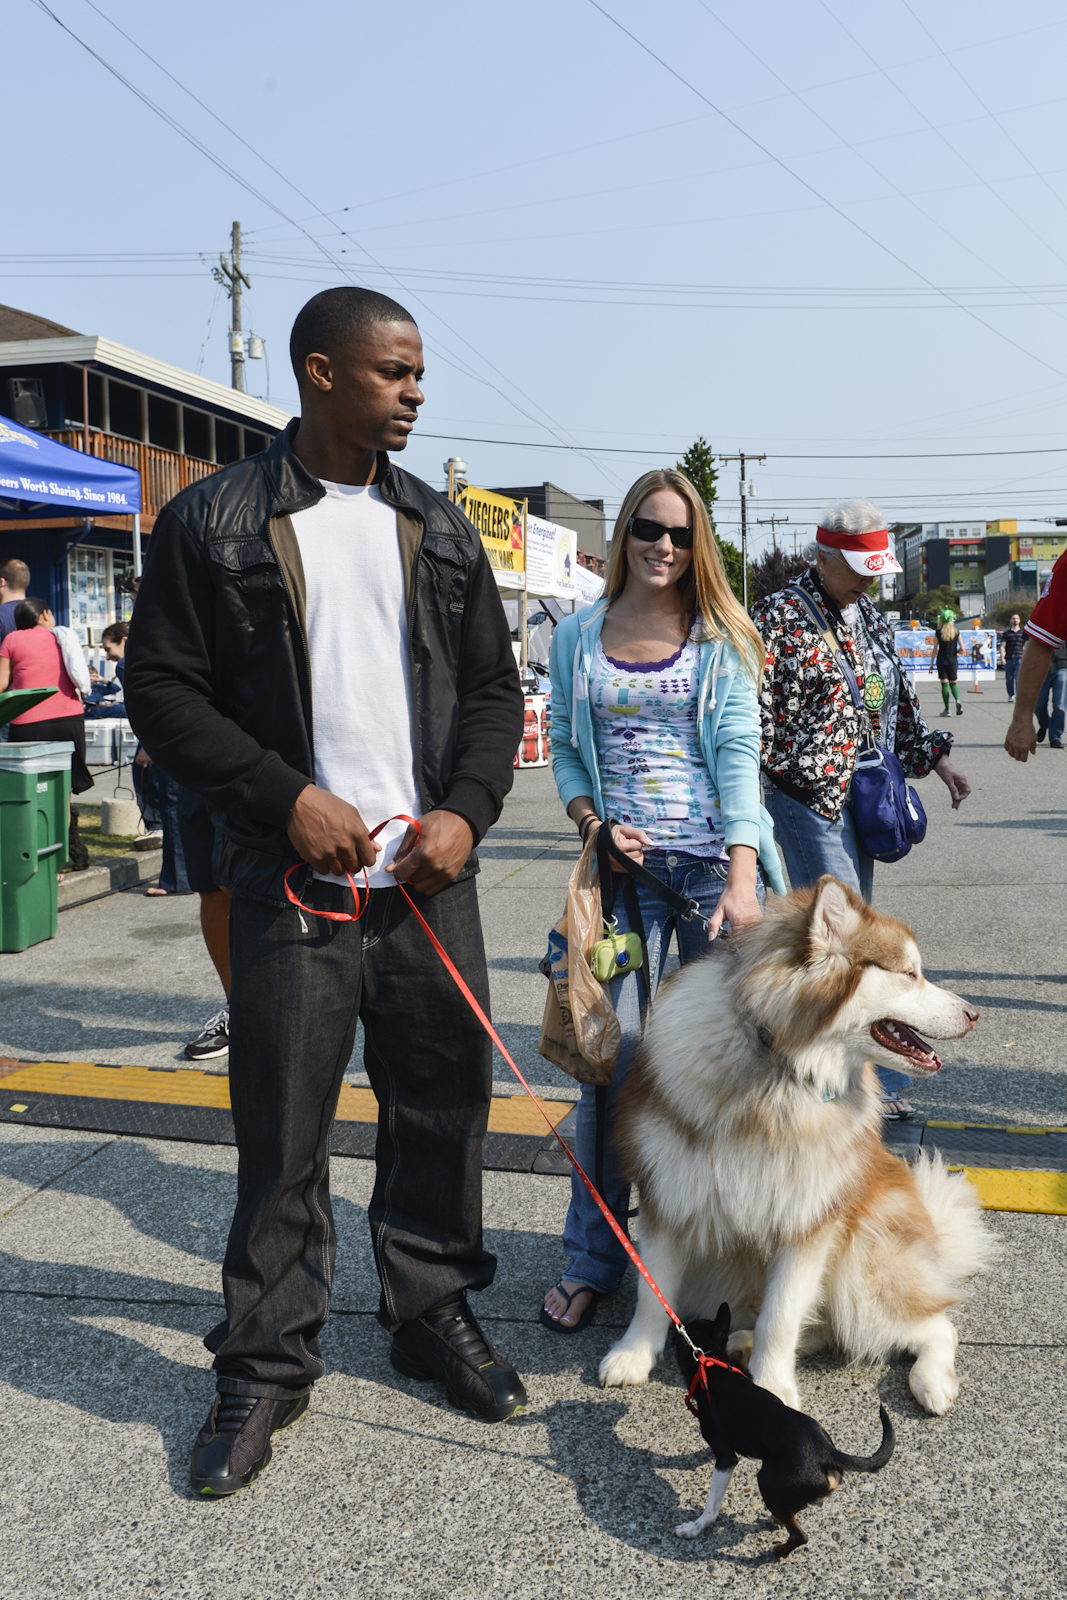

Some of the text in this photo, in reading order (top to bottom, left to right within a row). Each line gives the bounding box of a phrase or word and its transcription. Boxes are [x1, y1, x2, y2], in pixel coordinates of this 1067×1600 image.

[0, 476, 19, 489] eers
[20, 477, 48, 493] Worth
[83, 487, 106, 502] Since
[107, 491, 128, 505] 1984.
[468, 498, 510, 541] ZIEGLERS
[533, 523, 556, 541] Energized!
[865, 556, 883, 569] Coca
